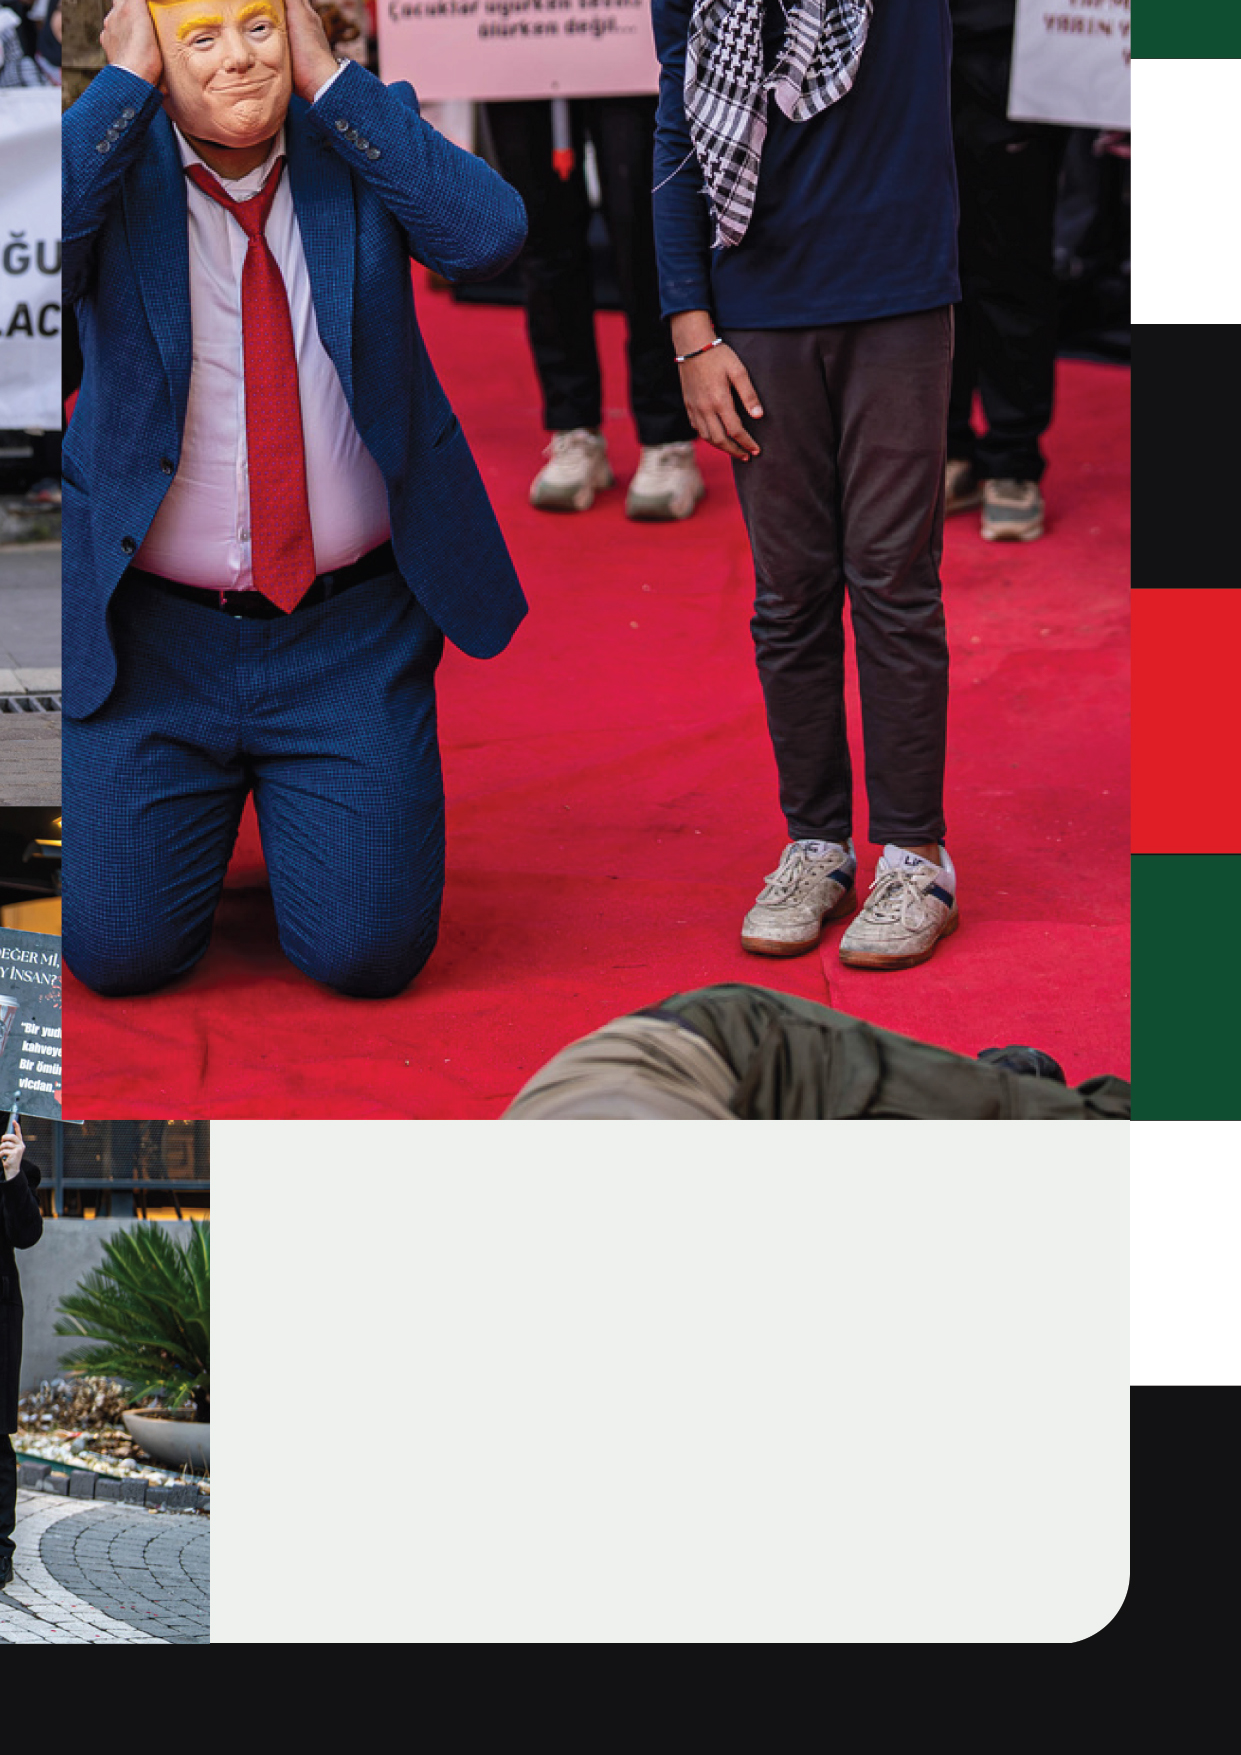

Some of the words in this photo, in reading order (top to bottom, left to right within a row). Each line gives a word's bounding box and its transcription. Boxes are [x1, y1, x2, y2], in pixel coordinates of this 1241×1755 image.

[40, 952, 60, 969] Mİ,
[10, 965, 57, 986] İNSAN?
[19, 1058, 34, 1071] Bir
